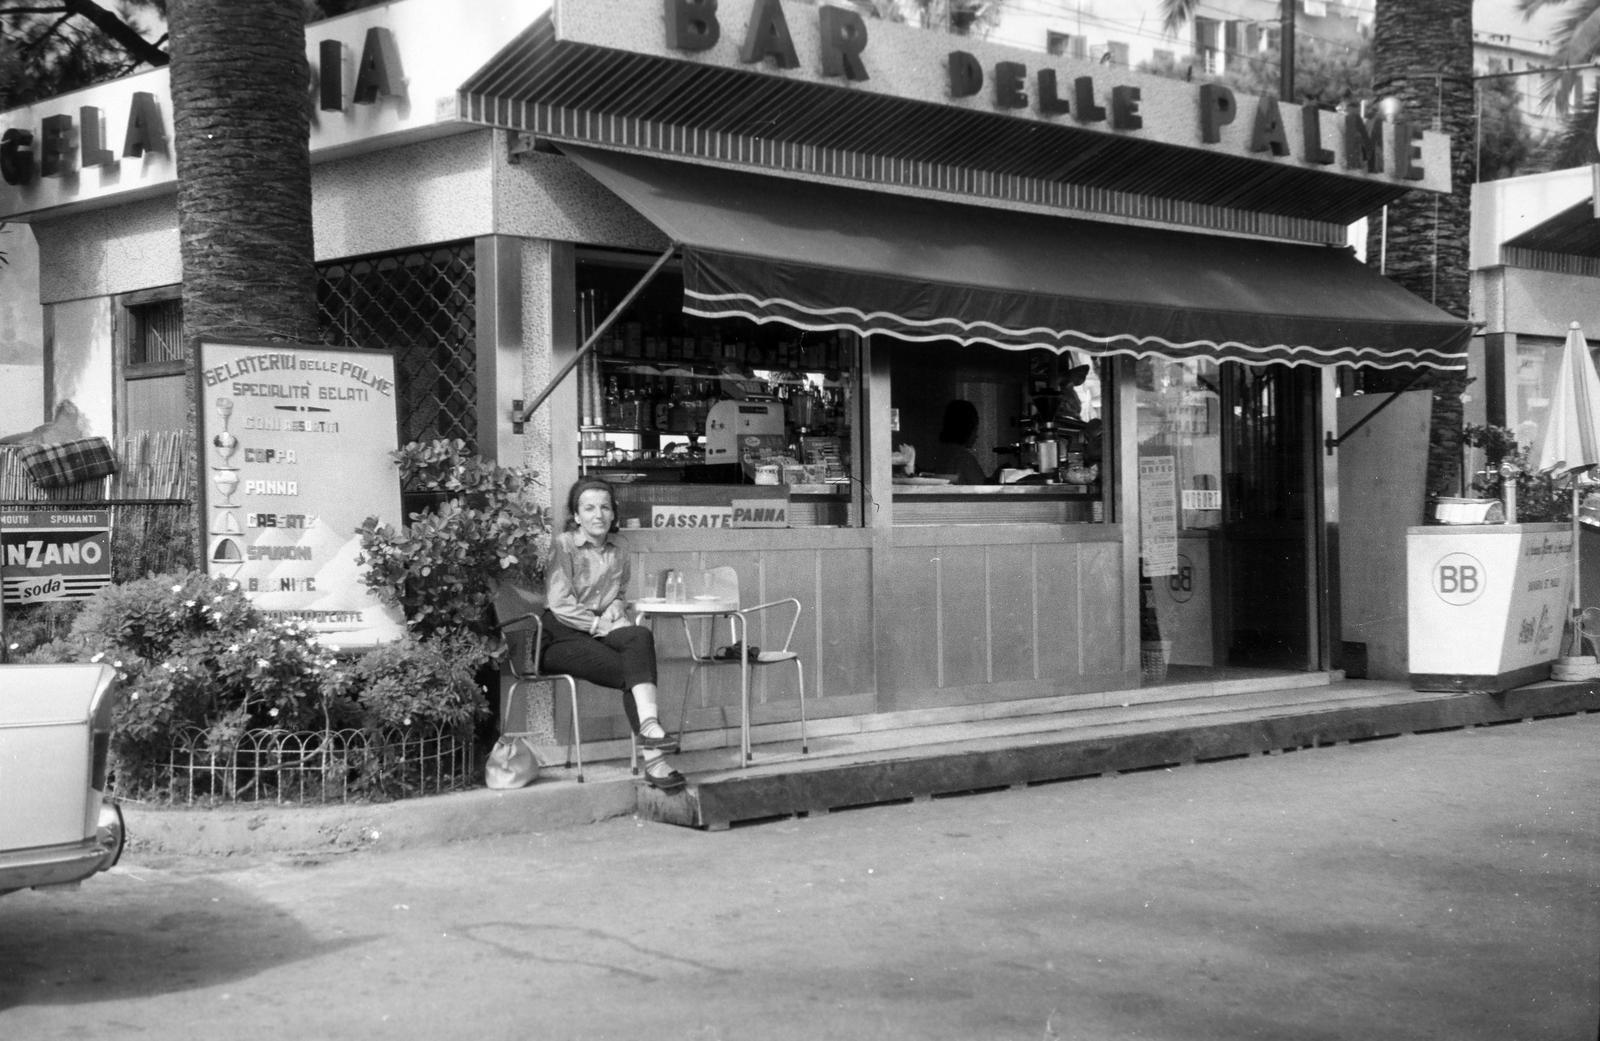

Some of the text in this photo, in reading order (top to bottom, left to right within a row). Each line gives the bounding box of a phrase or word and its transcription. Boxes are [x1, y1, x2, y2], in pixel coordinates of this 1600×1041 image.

[664, 0, 1425, 182] BAR DELLE PALME
[1, 27, 397, 186] GELAIA
[204, 353, 394, 397] GELATERIA DELLE PALME
[318, 385, 368, 401] GELATI
[244, 447, 297, 464] COPPA
[245, 479, 299, 496] PANNA
[50, 514, 97, 524] SPUMANTI
[247, 512, 315, 529] CASSATE
[653, 513, 732, 528] CASSATE
[733, 508, 786, 522] PANNA
[1440, 565, 1478, 593] BB
[23, 578, 61, 598] soda
